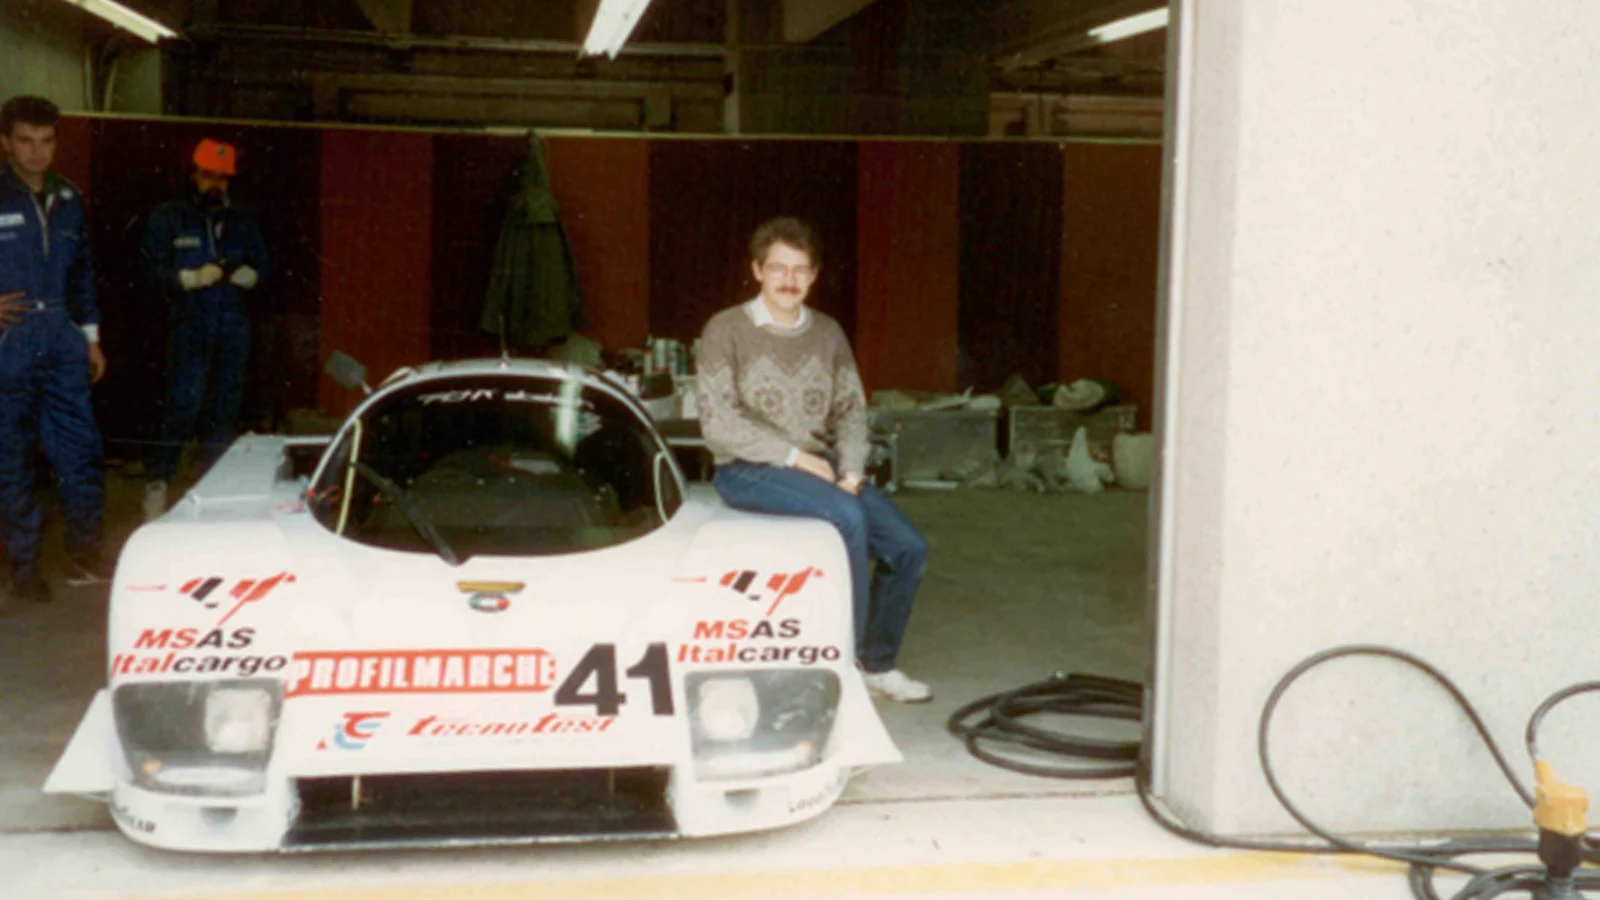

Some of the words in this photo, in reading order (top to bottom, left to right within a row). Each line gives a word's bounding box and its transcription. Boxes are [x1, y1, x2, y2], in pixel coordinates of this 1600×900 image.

[134, 627, 256, 649] MSAS
[693, 618, 800, 640] MSAS
[111, 651, 287, 677] Italcargo
[677, 641, 840, 665] Italcargo
[554, 641, 675, 717] 41
